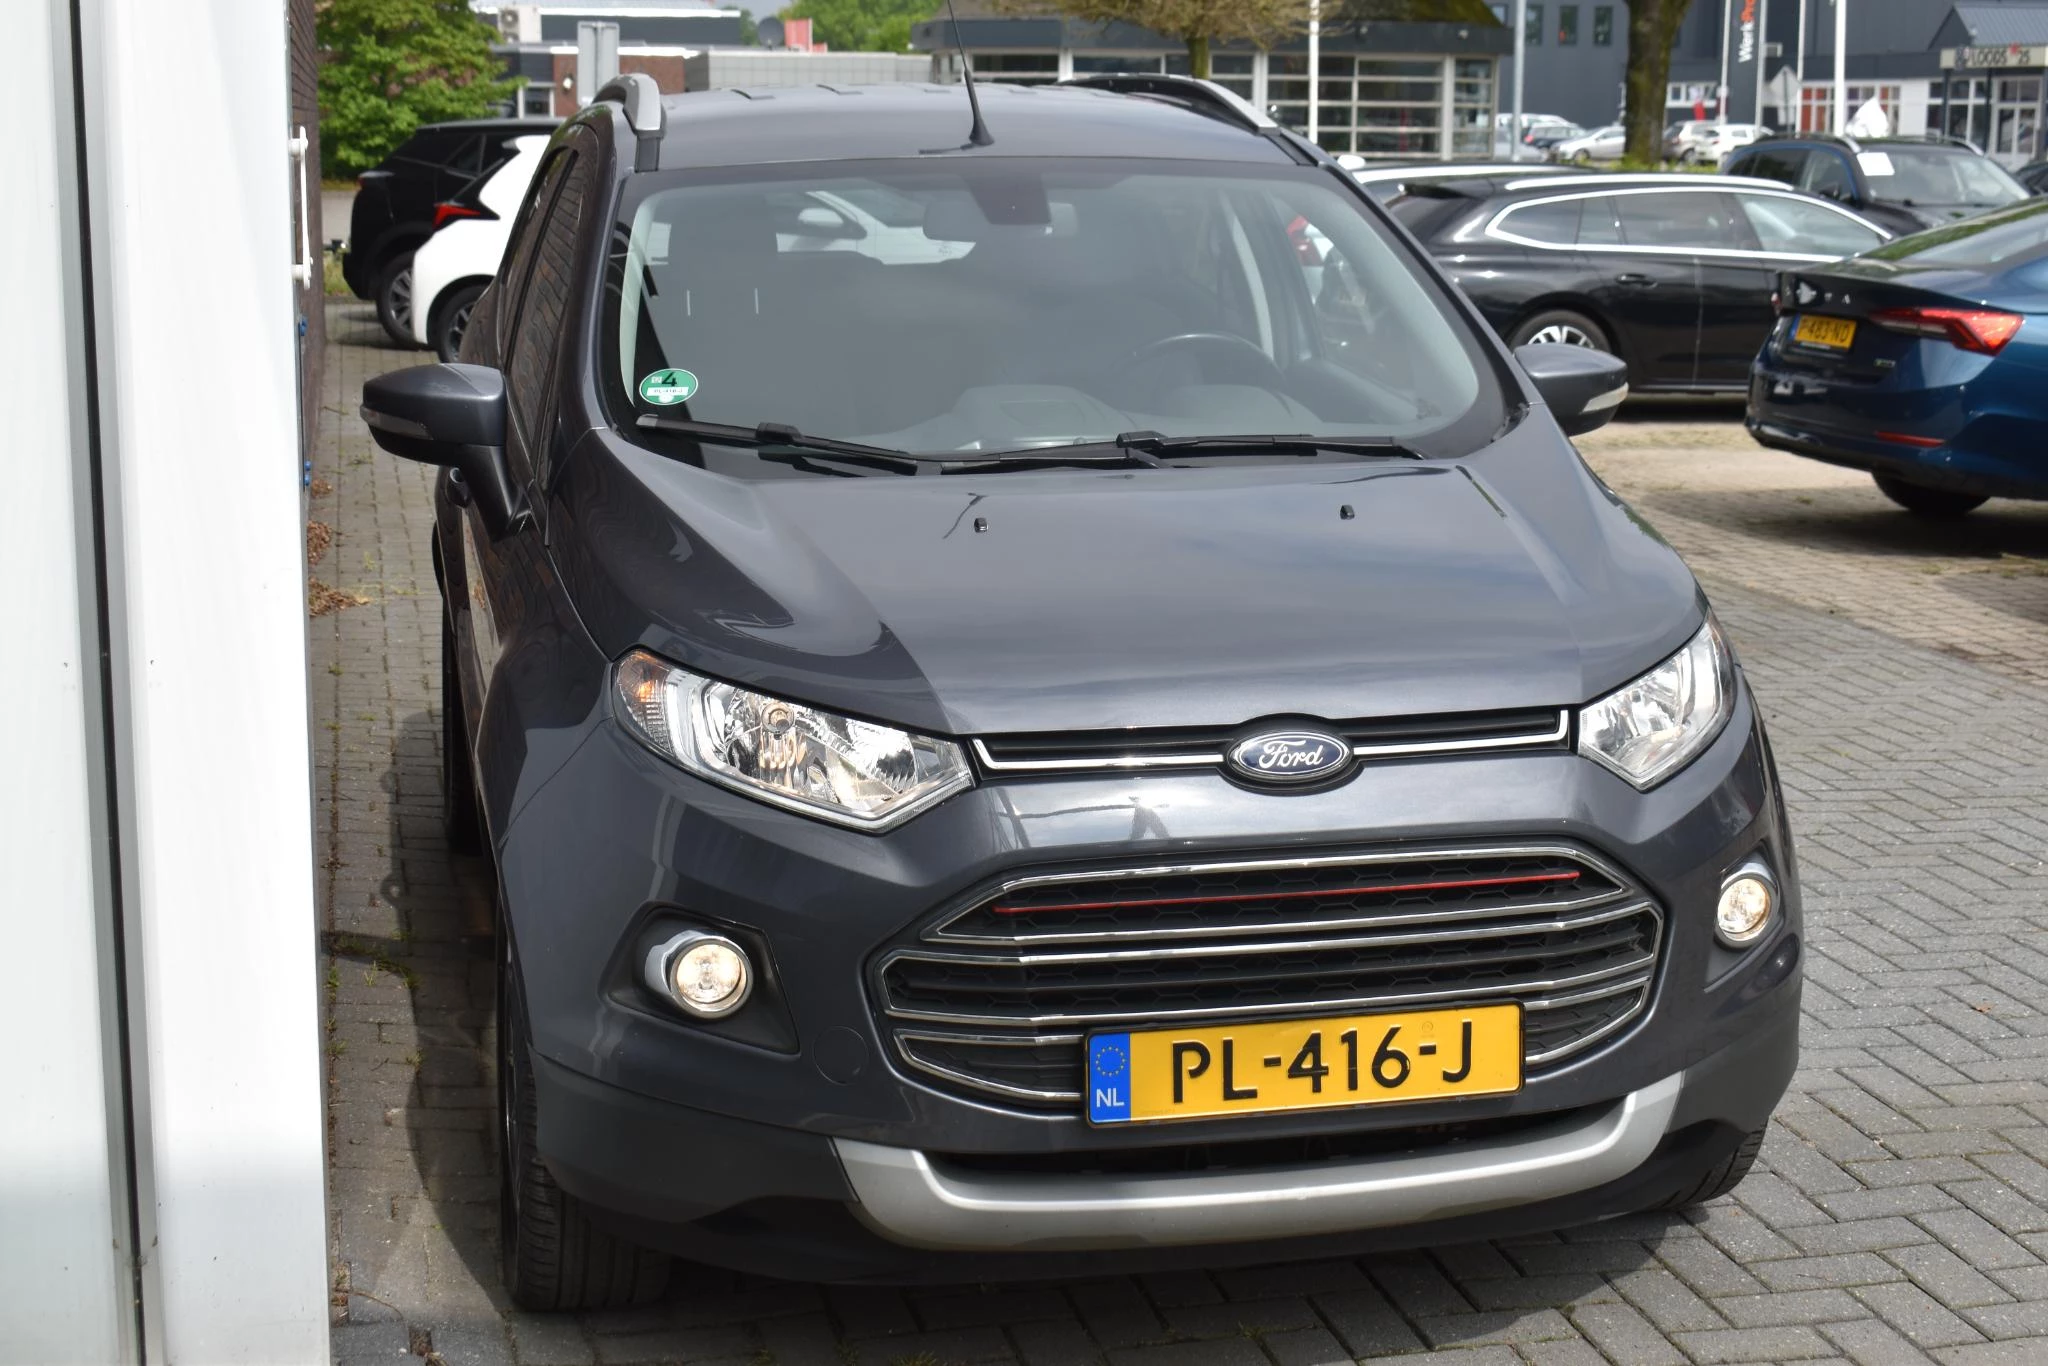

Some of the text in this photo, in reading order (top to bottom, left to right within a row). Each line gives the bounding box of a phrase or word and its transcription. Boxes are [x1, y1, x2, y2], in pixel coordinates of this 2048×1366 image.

[661, 371, 678, 387] 4
[1258, 739, 1324, 769] Ford
[1171, 1019, 1474, 1104] PL-416-J
[1096, 1087, 1125, 1108] NL
